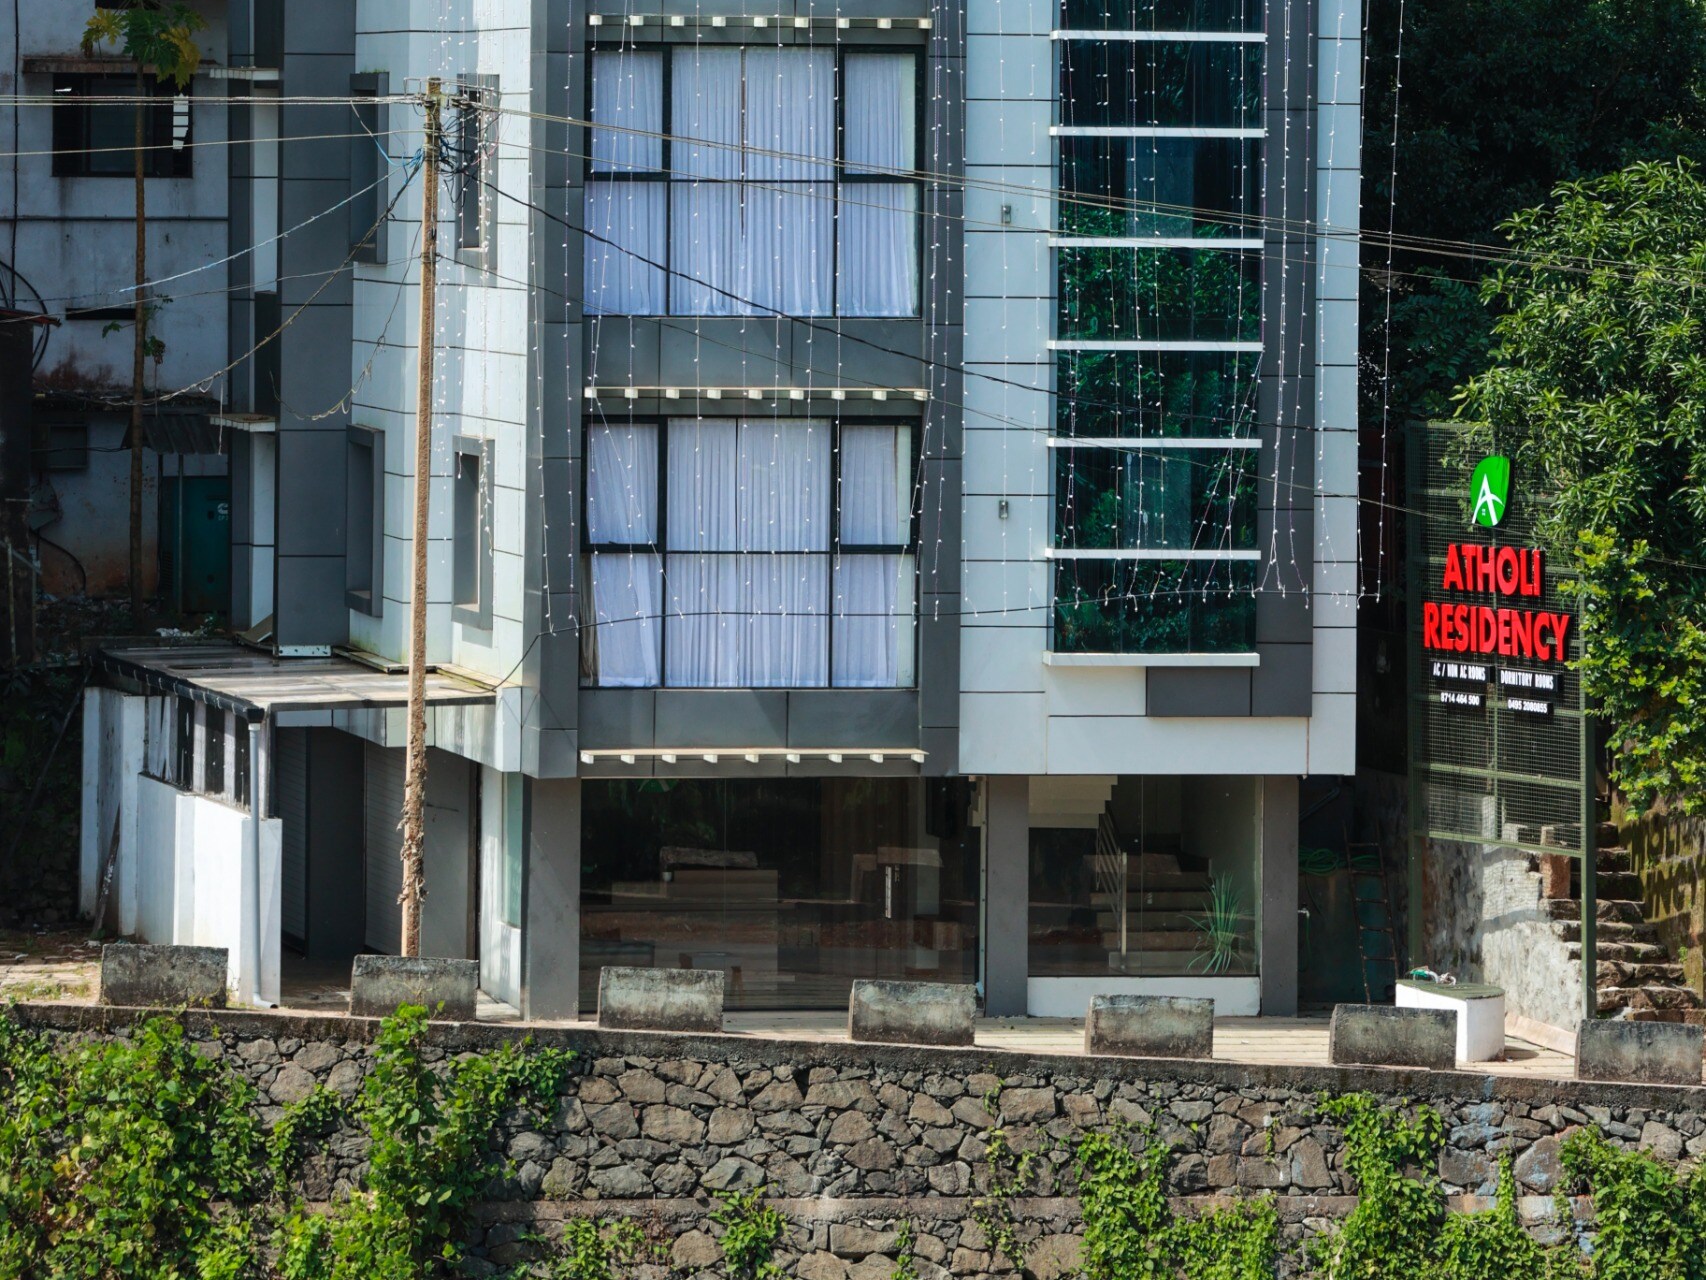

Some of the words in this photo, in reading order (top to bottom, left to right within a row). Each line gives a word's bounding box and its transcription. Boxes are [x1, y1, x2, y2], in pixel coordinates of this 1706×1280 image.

[1443, 543, 1541, 597] ATHOLI
[1423, 602, 1570, 662] RESIDENCY
[1433, 662, 1441, 677] AC
[1460, 664, 1468, 679] AC
[1468, 665, 1486, 681] ROOMS
[1500, 670, 1533, 687] DORMITORY
[1535, 673, 1554, 690] ROOMS
